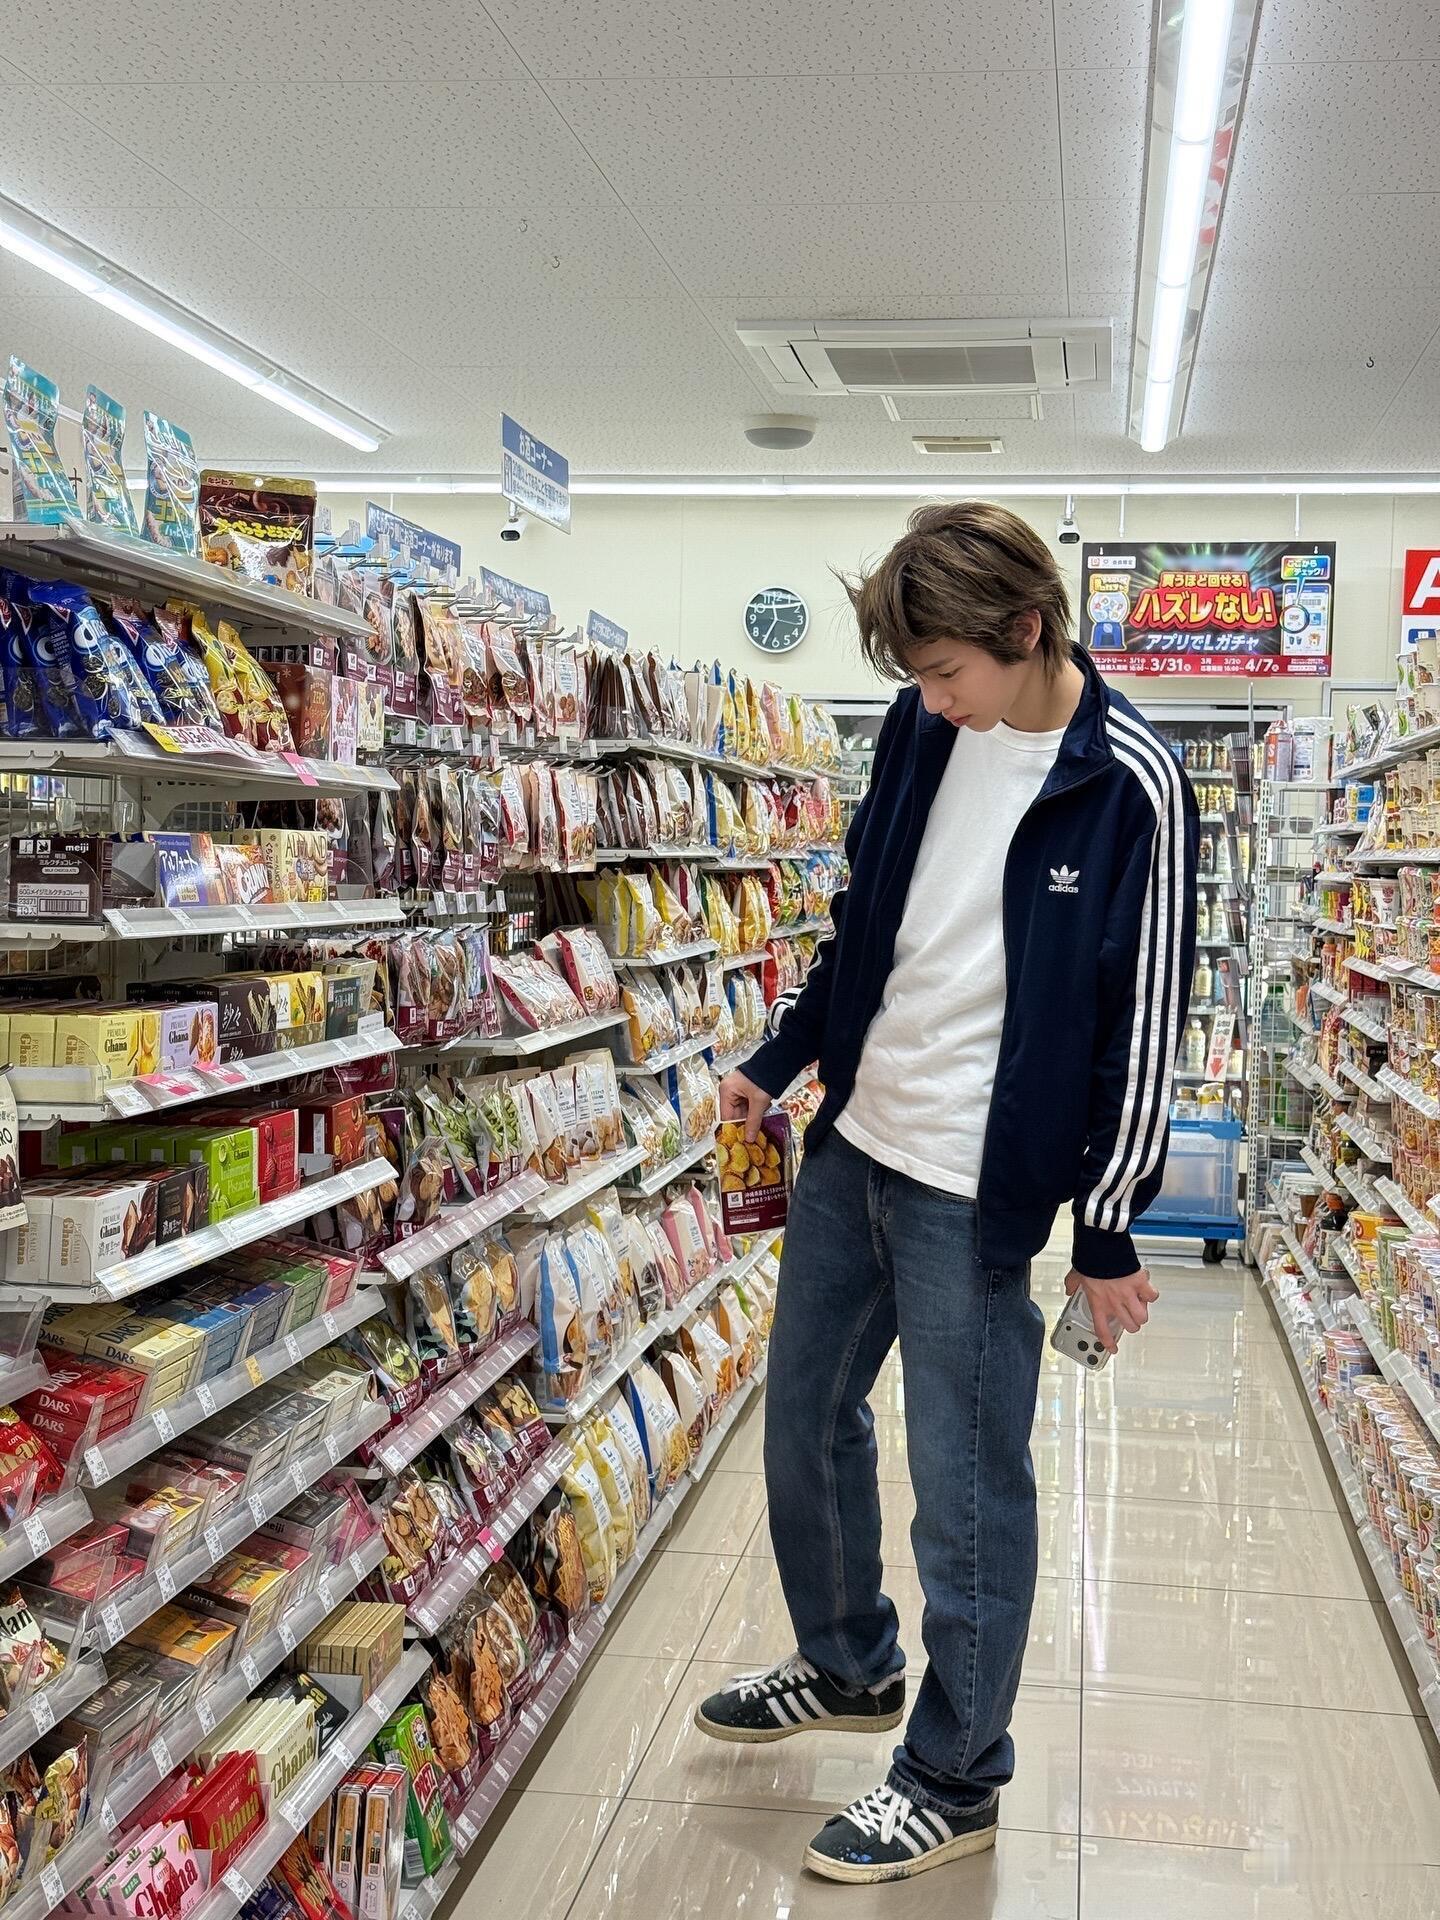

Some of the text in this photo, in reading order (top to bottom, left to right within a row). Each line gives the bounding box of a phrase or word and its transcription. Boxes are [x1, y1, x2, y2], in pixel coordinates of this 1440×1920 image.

[1294, 567, 1325, 576] チェック!
[1162, 574, 1247, 587] 買うほど回せる!
[772, 591, 783, 602] 12
[1134, 591, 1273, 624] ハズレなし!
[749, 614, 757, 624] 9
[753, 627, 759, 637] 8
[792, 628, 799, 637] 4
[771, 637, 780, 648] 6
[783, 635, 791, 645] 5
[1146, 634, 1260, 651] アプリでLガチャ
[65, 843, 89, 853] meiji
[159, 850, 198, 872] アルフォート
[1049, 884, 1079, 893] adidas
[169, 1031, 189, 1044] Ghana
[105, 1039, 128, 1053] Ghana
[100, 1225, 120, 1239] Ghana
[17, 1222, 29, 1265] hana
[61, 1217, 74, 1267] Ghana
[95, 1322, 144, 1344] DARS
[105, 1346, 136, 1364] DARS
[39, 1394, 71, 1414] DARS
[32, 1413, 65, 1433] DARS
[189, 1594, 216, 1607] LOTTE
[271, 1736, 314, 1799] Ghana
[209, 1791, 260, 1852] Ghana
[135, 1859, 199, 1920] Ghana
